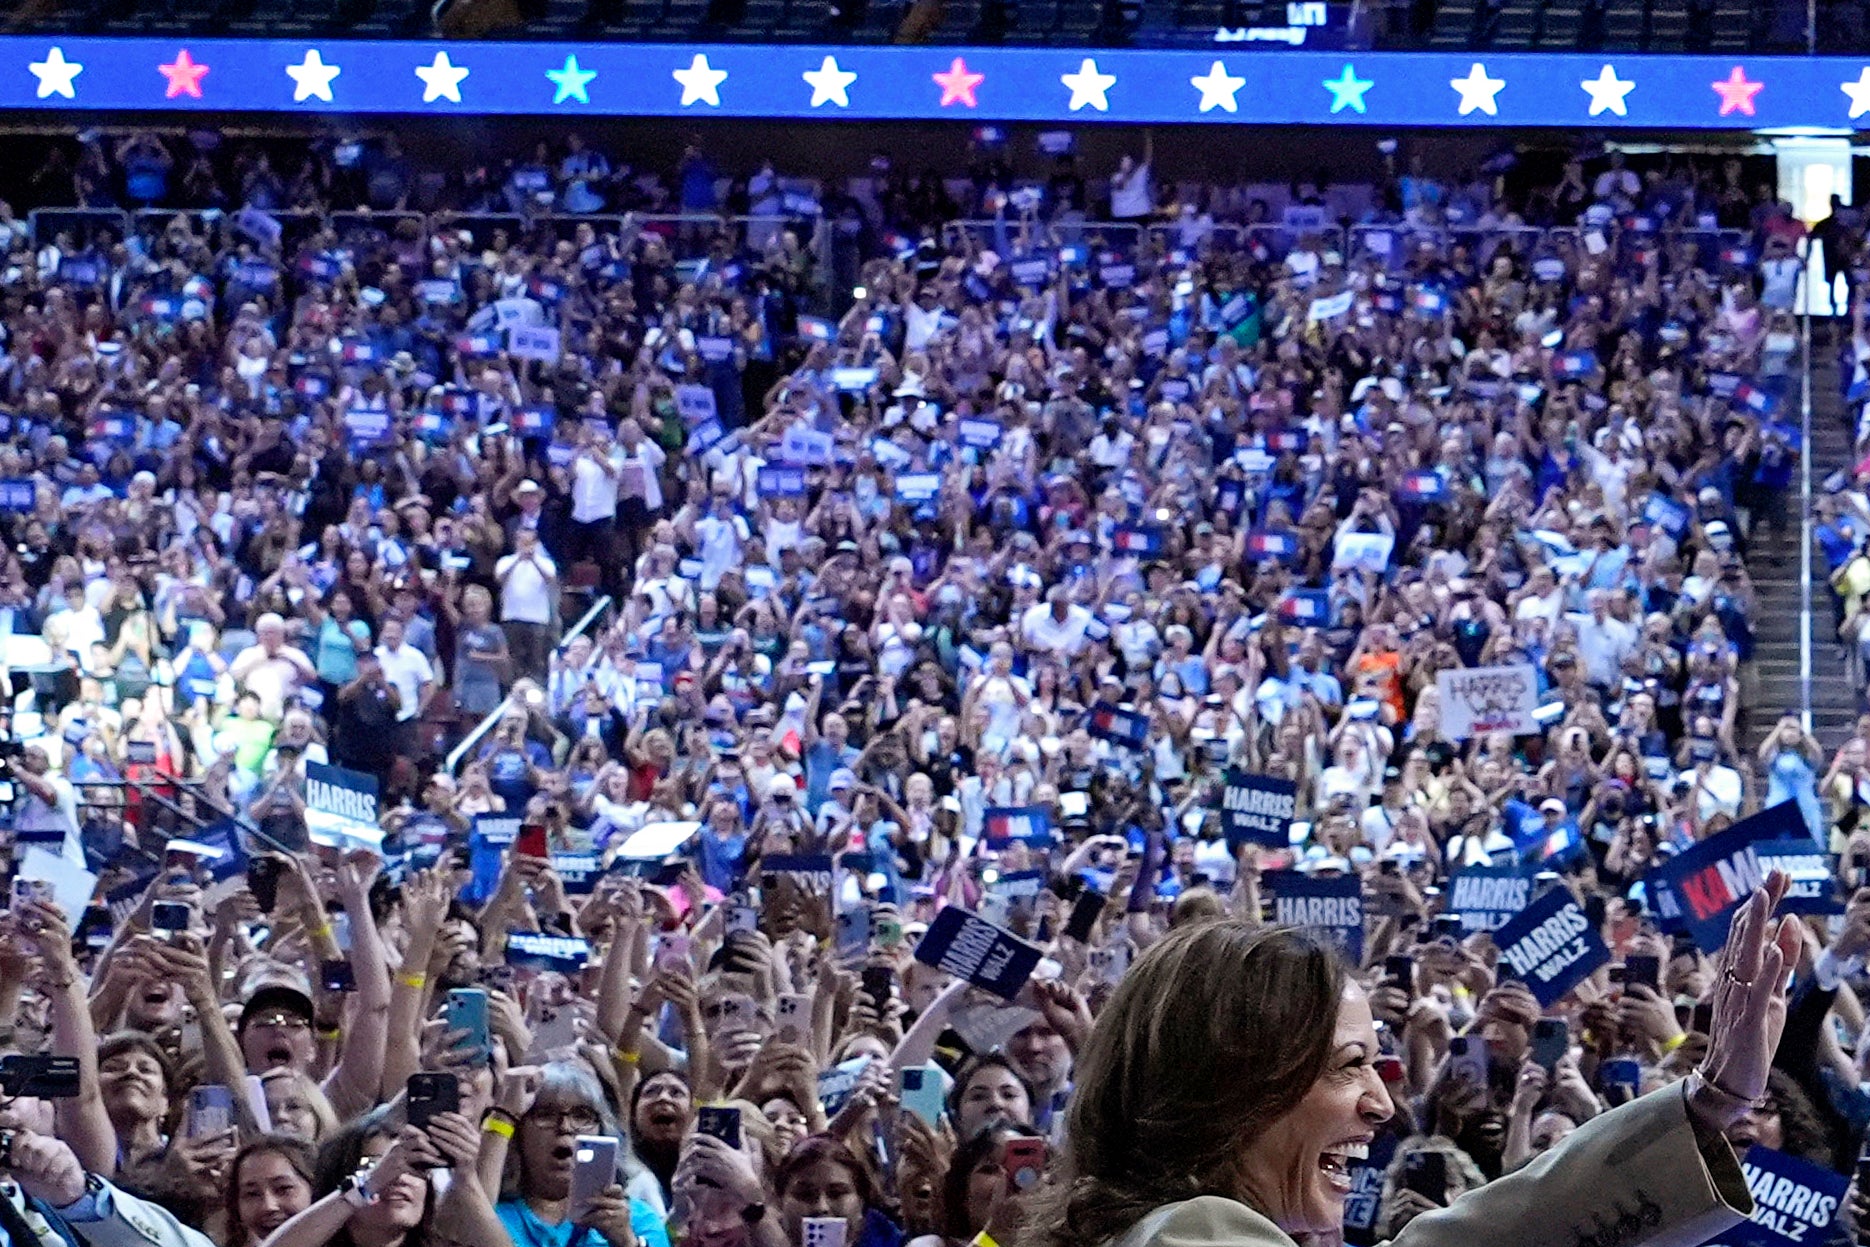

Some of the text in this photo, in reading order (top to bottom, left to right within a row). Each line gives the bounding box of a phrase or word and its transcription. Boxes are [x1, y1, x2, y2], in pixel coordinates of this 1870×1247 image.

[306, 777, 377, 823] HARRIS
[1223, 785, 1294, 820] HARRIS
[1233, 812, 1281, 833] WALZ
[1277, 896, 1360, 927] HARRIS
[1452, 876, 1529, 912] HARRIS
[938, 917, 999, 982] HARRIS
[1506, 902, 1588, 976] HARRIS
[1535, 937, 1590, 982] WALZ
[1742, 1163, 1837, 1227] HARRIS
